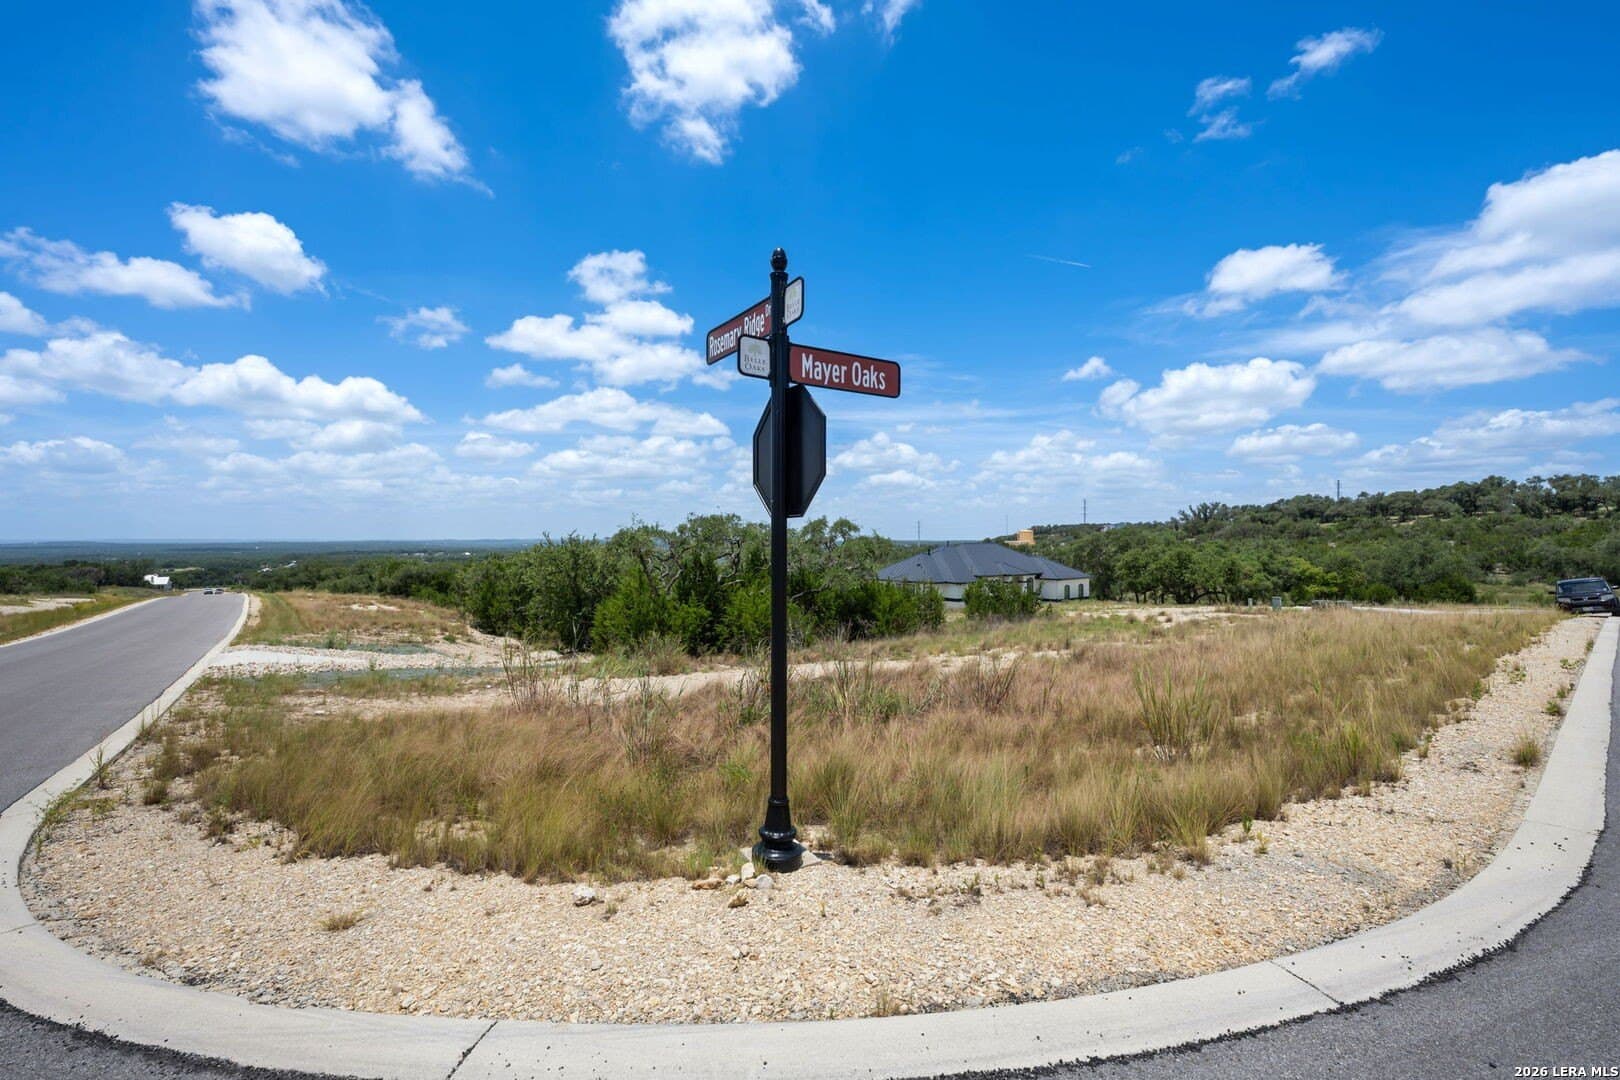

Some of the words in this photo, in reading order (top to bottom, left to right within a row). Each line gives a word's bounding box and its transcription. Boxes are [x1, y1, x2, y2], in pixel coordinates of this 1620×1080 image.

[744, 312, 765, 337] Ridge
[801, 352, 847, 385] Mayer
[851, 361, 886, 390] Oaks
